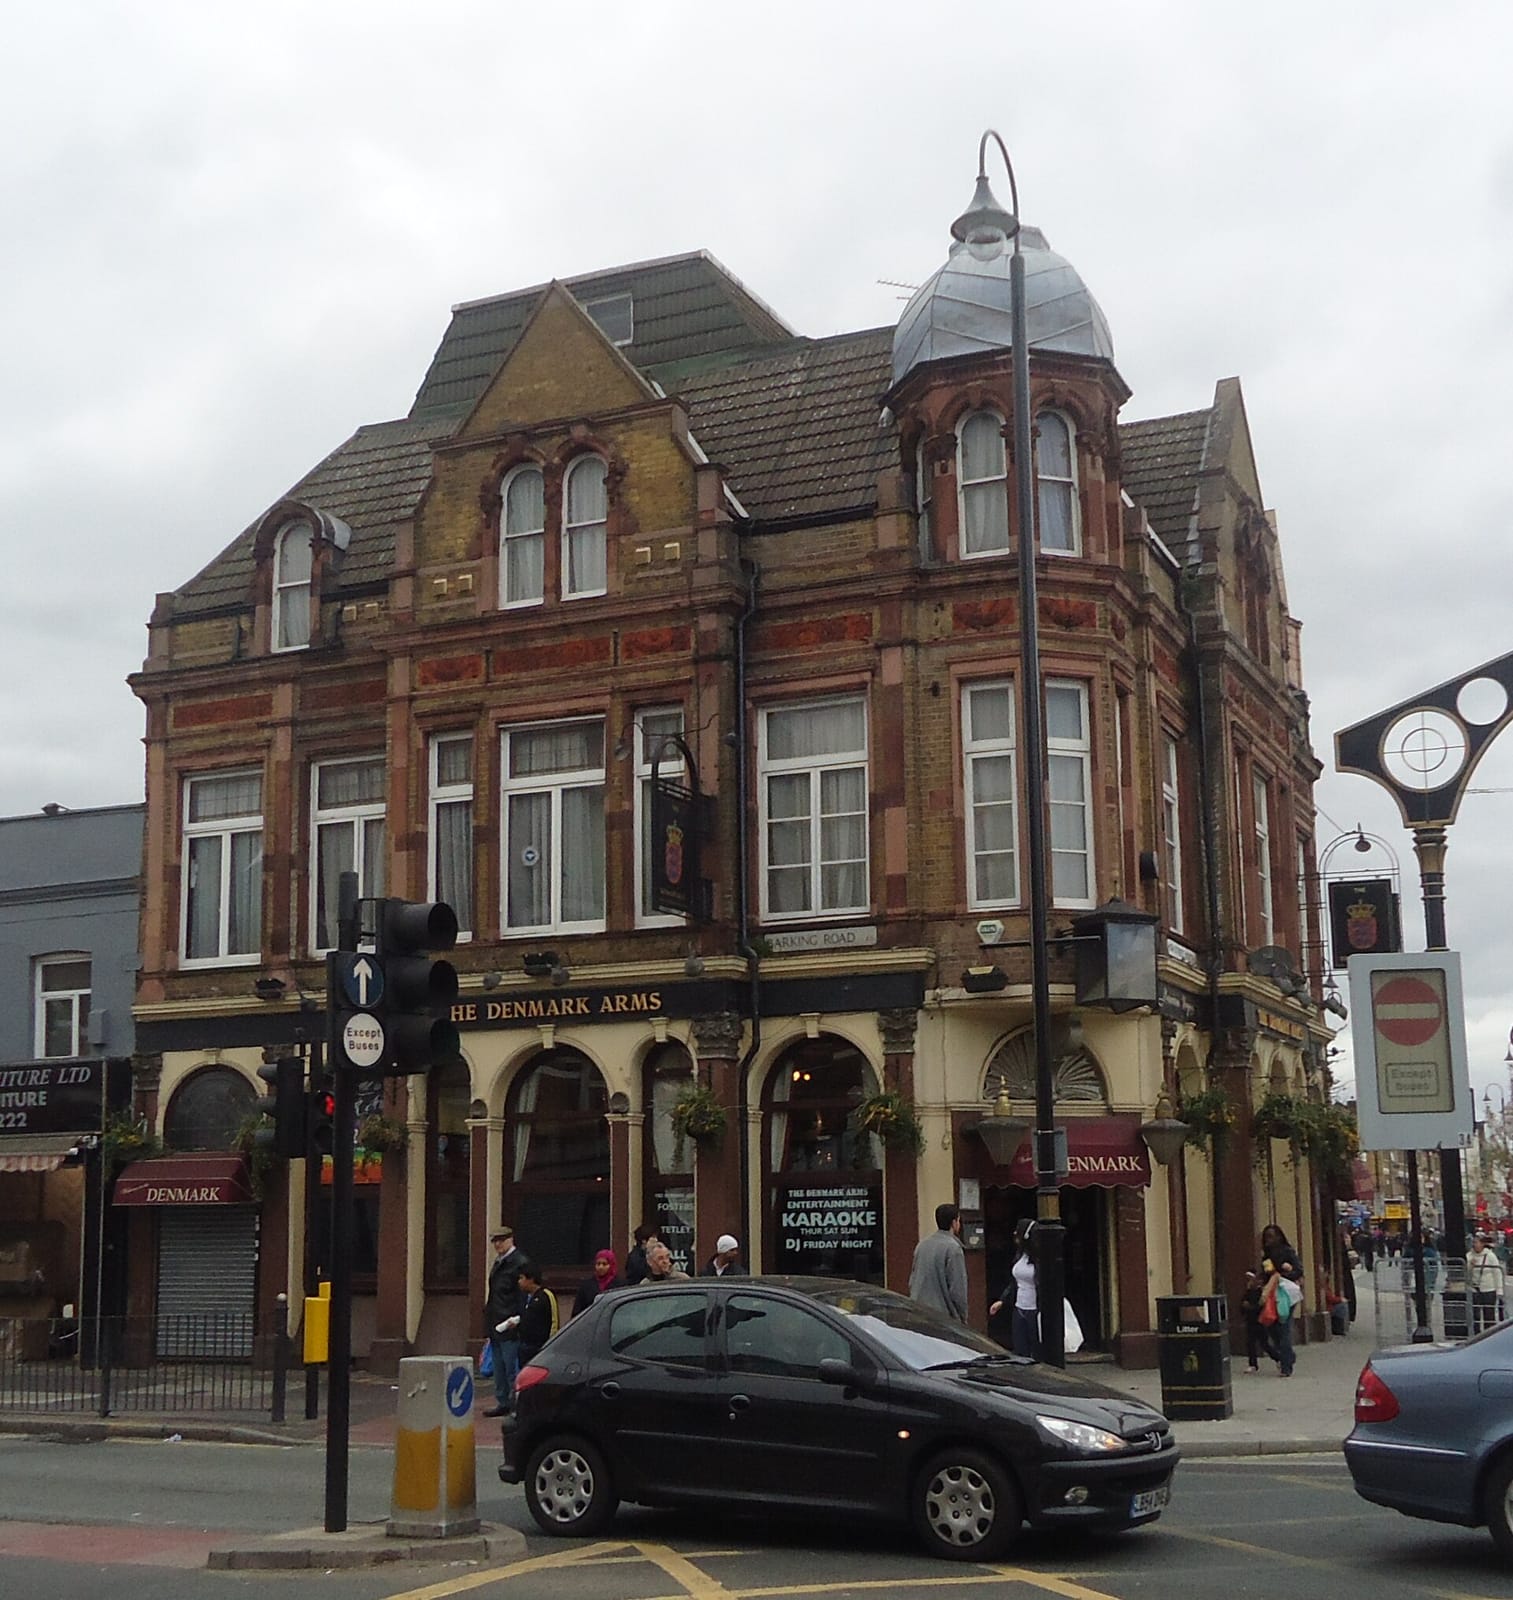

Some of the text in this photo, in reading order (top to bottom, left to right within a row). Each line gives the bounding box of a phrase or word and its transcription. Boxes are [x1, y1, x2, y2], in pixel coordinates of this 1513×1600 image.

[823, 932, 856, 945] ROAD
[450, 992, 662, 1022] HE DENMARK ARMS
[347, 1027, 381, 1039] Except
[349, 1041, 380, 1051] Buses
[0, 1066, 91, 1087] ITURE LTD
[0, 1091, 47, 1107] ITURE
[1067, 1156, 1143, 1171] ENMARK
[146, 1187, 220, 1202] DENMARK
[788, 1188, 868, 1198] THE DENMARK ARMS
[787, 1200, 869, 1209] ENTERTAINMENT
[782, 1211, 876, 1227] KARAOKE
[824, 1227, 838, 1235] SAT
[785, 1238, 800, 1252] DJ
[841, 1240, 873, 1248] NIGHT
[674, 1261, 688, 1271] AY
